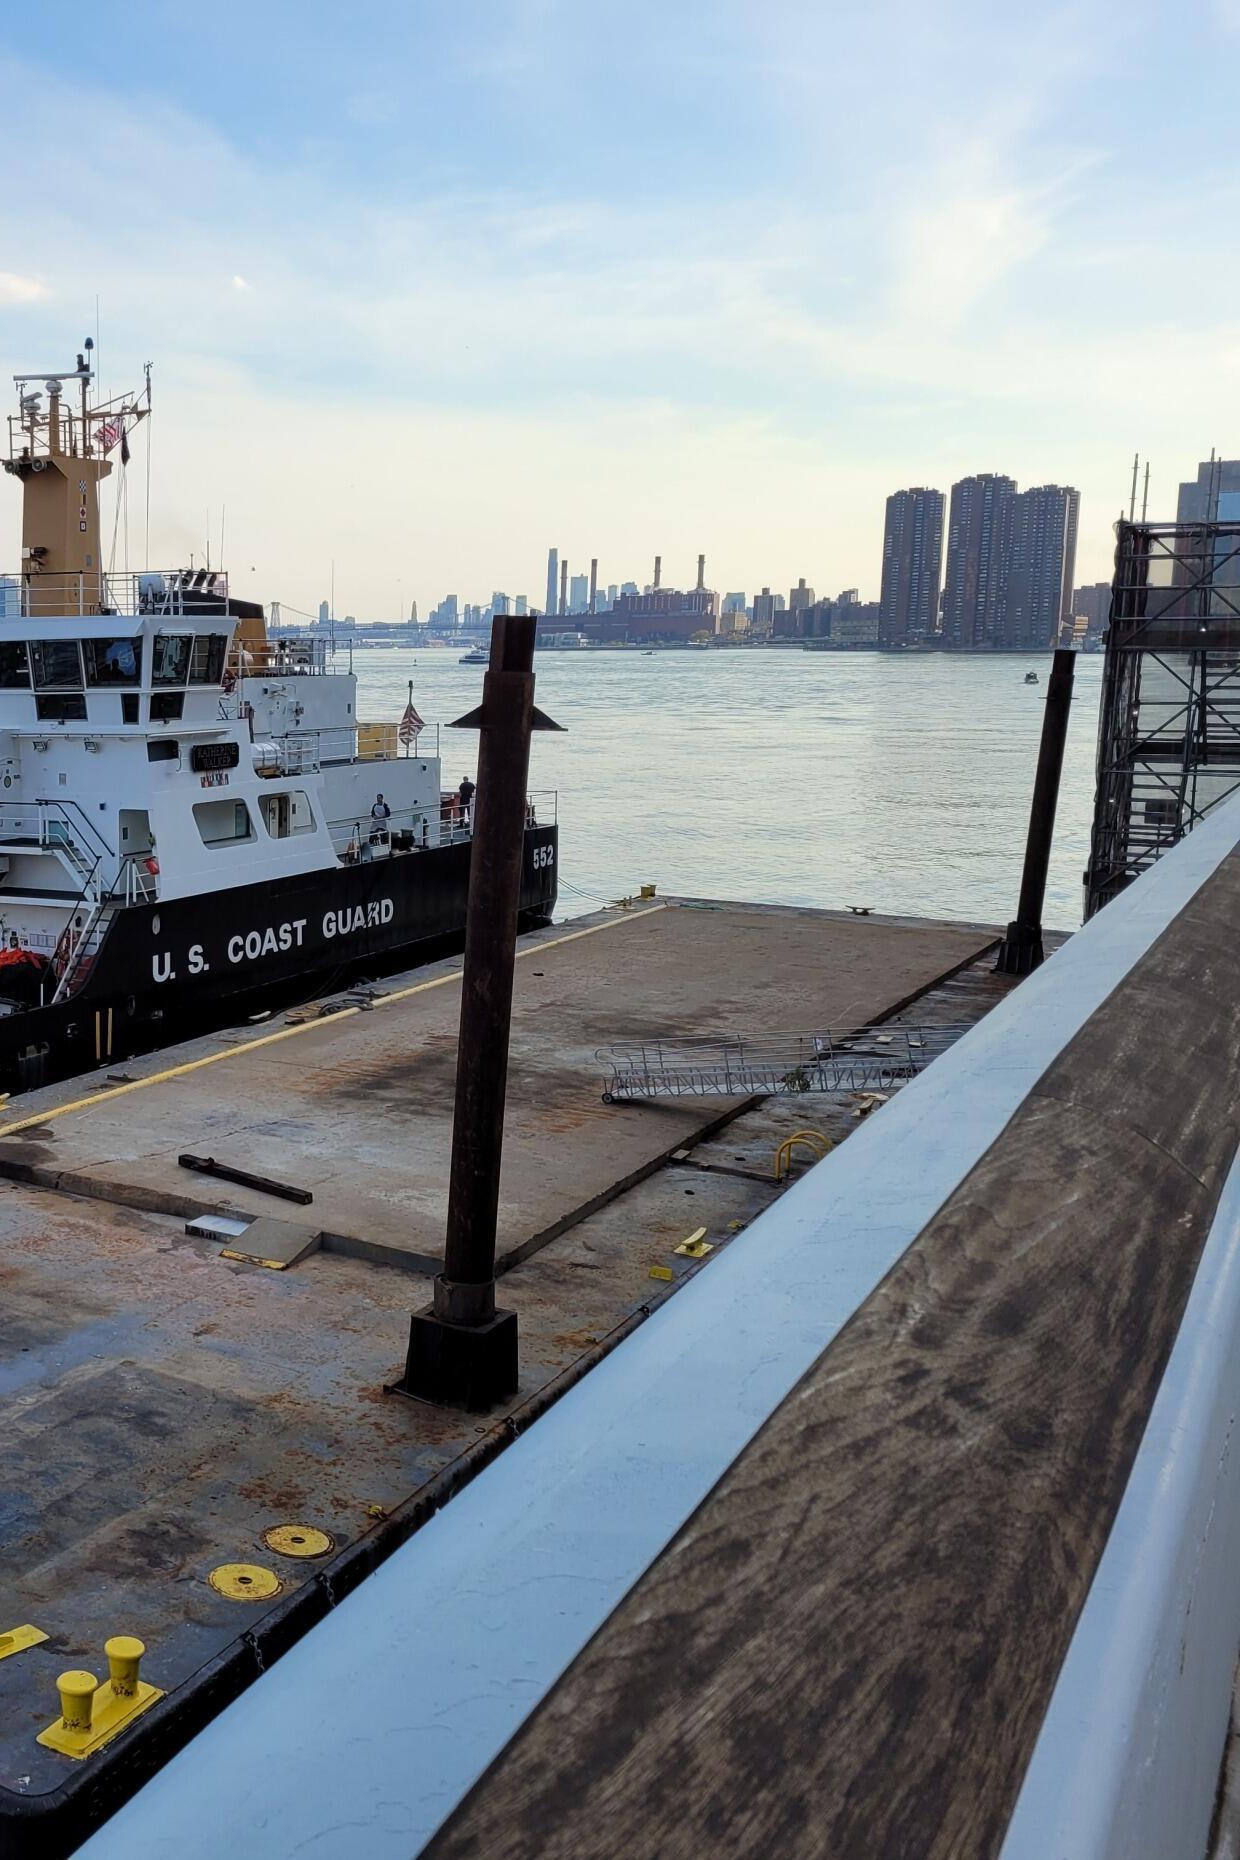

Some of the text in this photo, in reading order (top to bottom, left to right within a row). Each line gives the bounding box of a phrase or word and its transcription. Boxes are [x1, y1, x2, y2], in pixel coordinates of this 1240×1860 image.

[533, 844, 554, 870] 552
[152, 898, 394, 983] U. S. COAST GUARD
